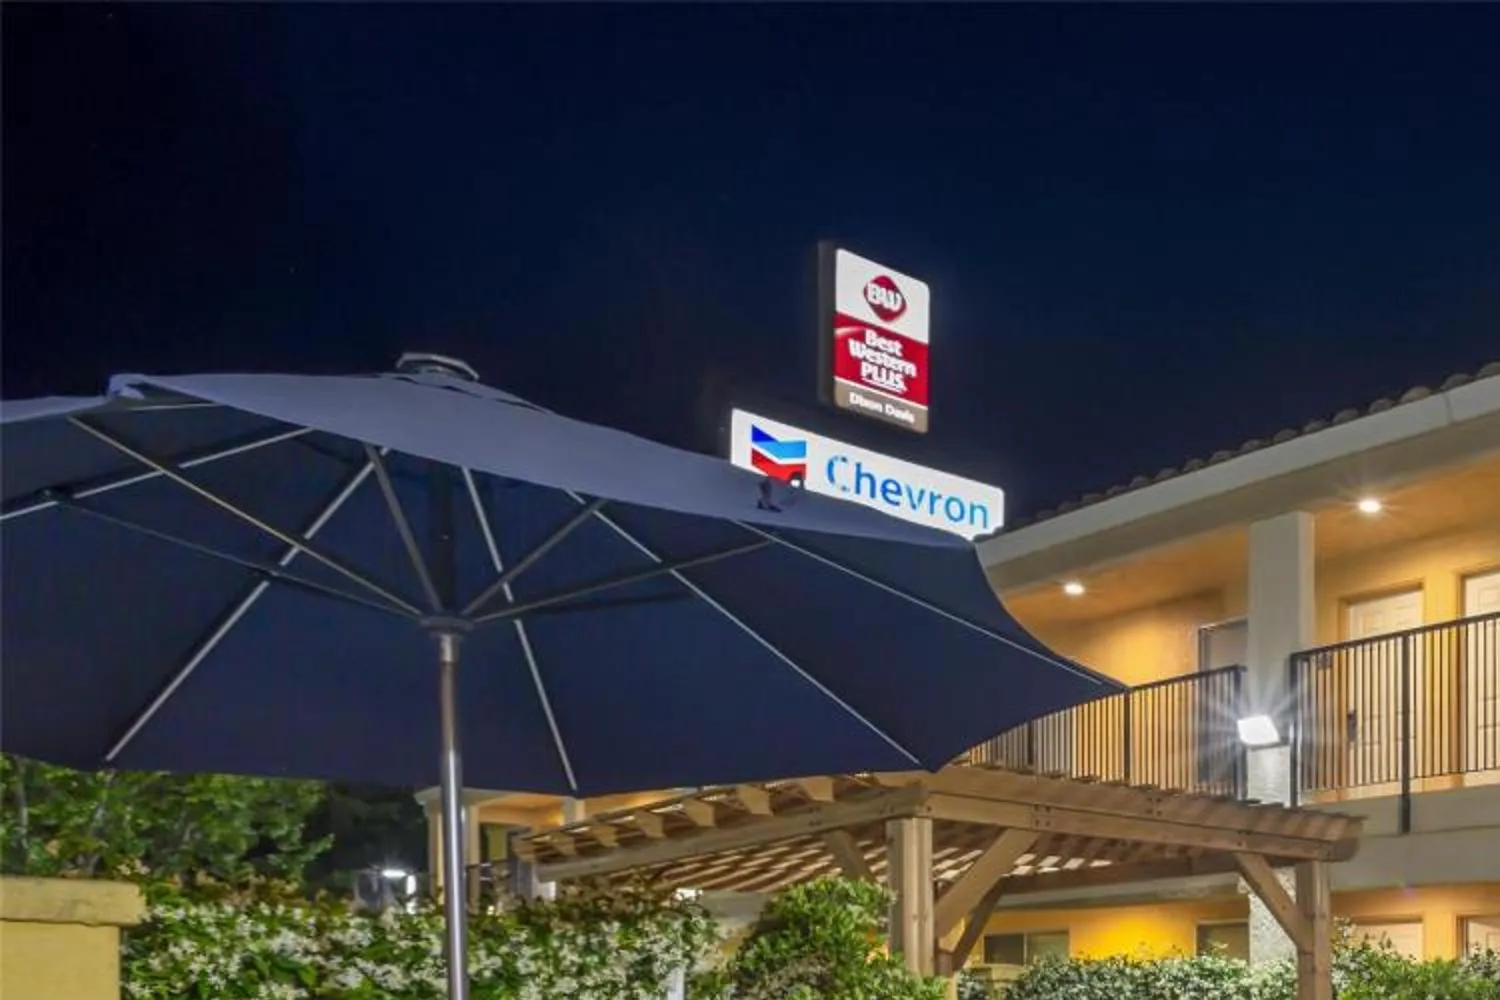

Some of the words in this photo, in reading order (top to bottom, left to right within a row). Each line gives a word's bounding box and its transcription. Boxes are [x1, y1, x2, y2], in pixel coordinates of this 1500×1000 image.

[848, 337, 917, 378] Western
[864, 328, 904, 356] Best
[860, 361, 907, 393] PLUS
[825, 455, 989, 529] Chevron
